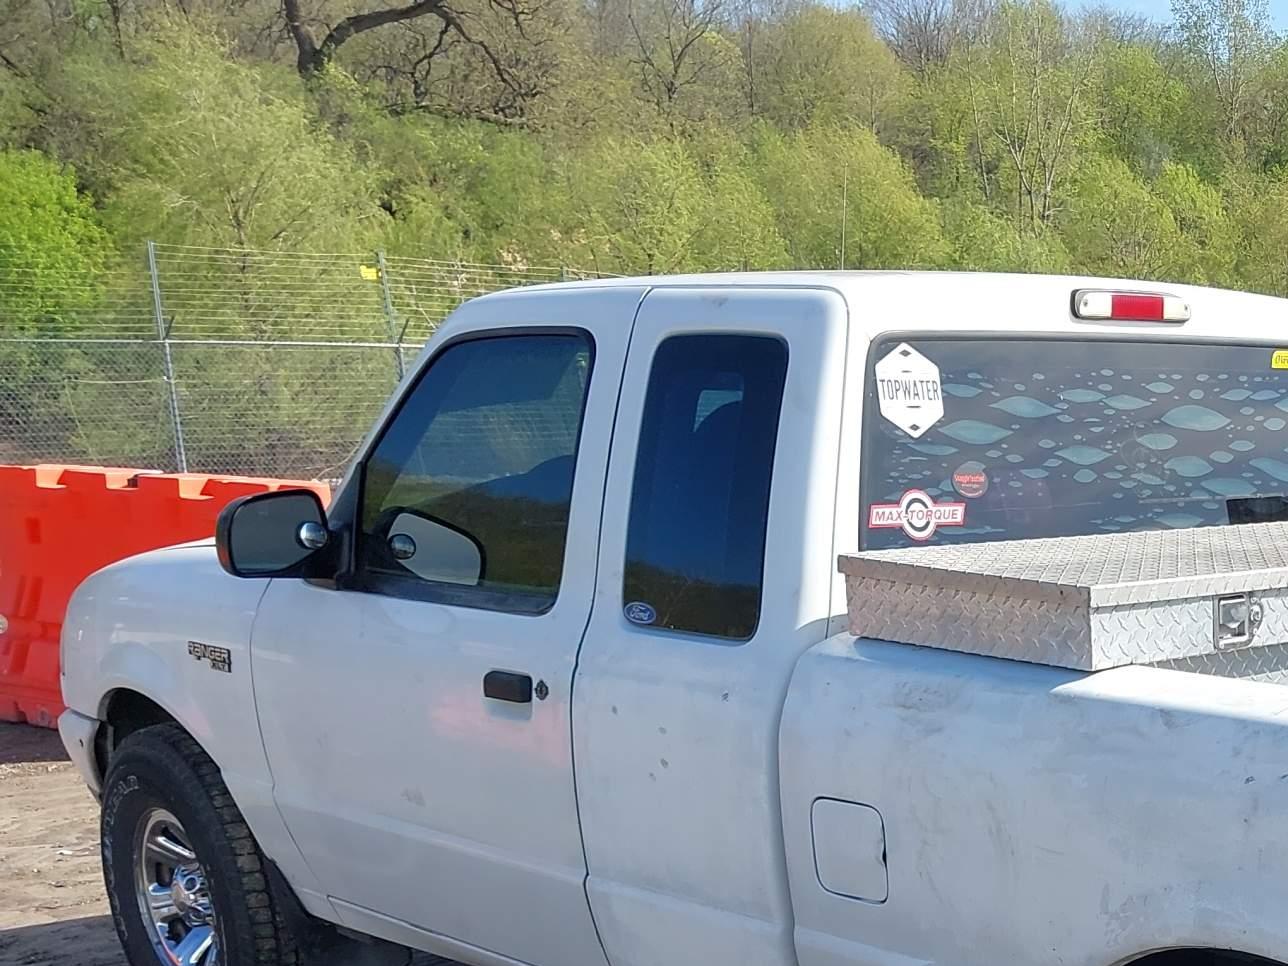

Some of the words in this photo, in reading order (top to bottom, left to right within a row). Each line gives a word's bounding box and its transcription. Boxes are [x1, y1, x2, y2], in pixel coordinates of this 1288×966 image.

[879, 378, 940, 401] TOPWATER
[874, 508, 959, 522] MAX-TORQUE
[188, 640, 231, 664] RANGER
